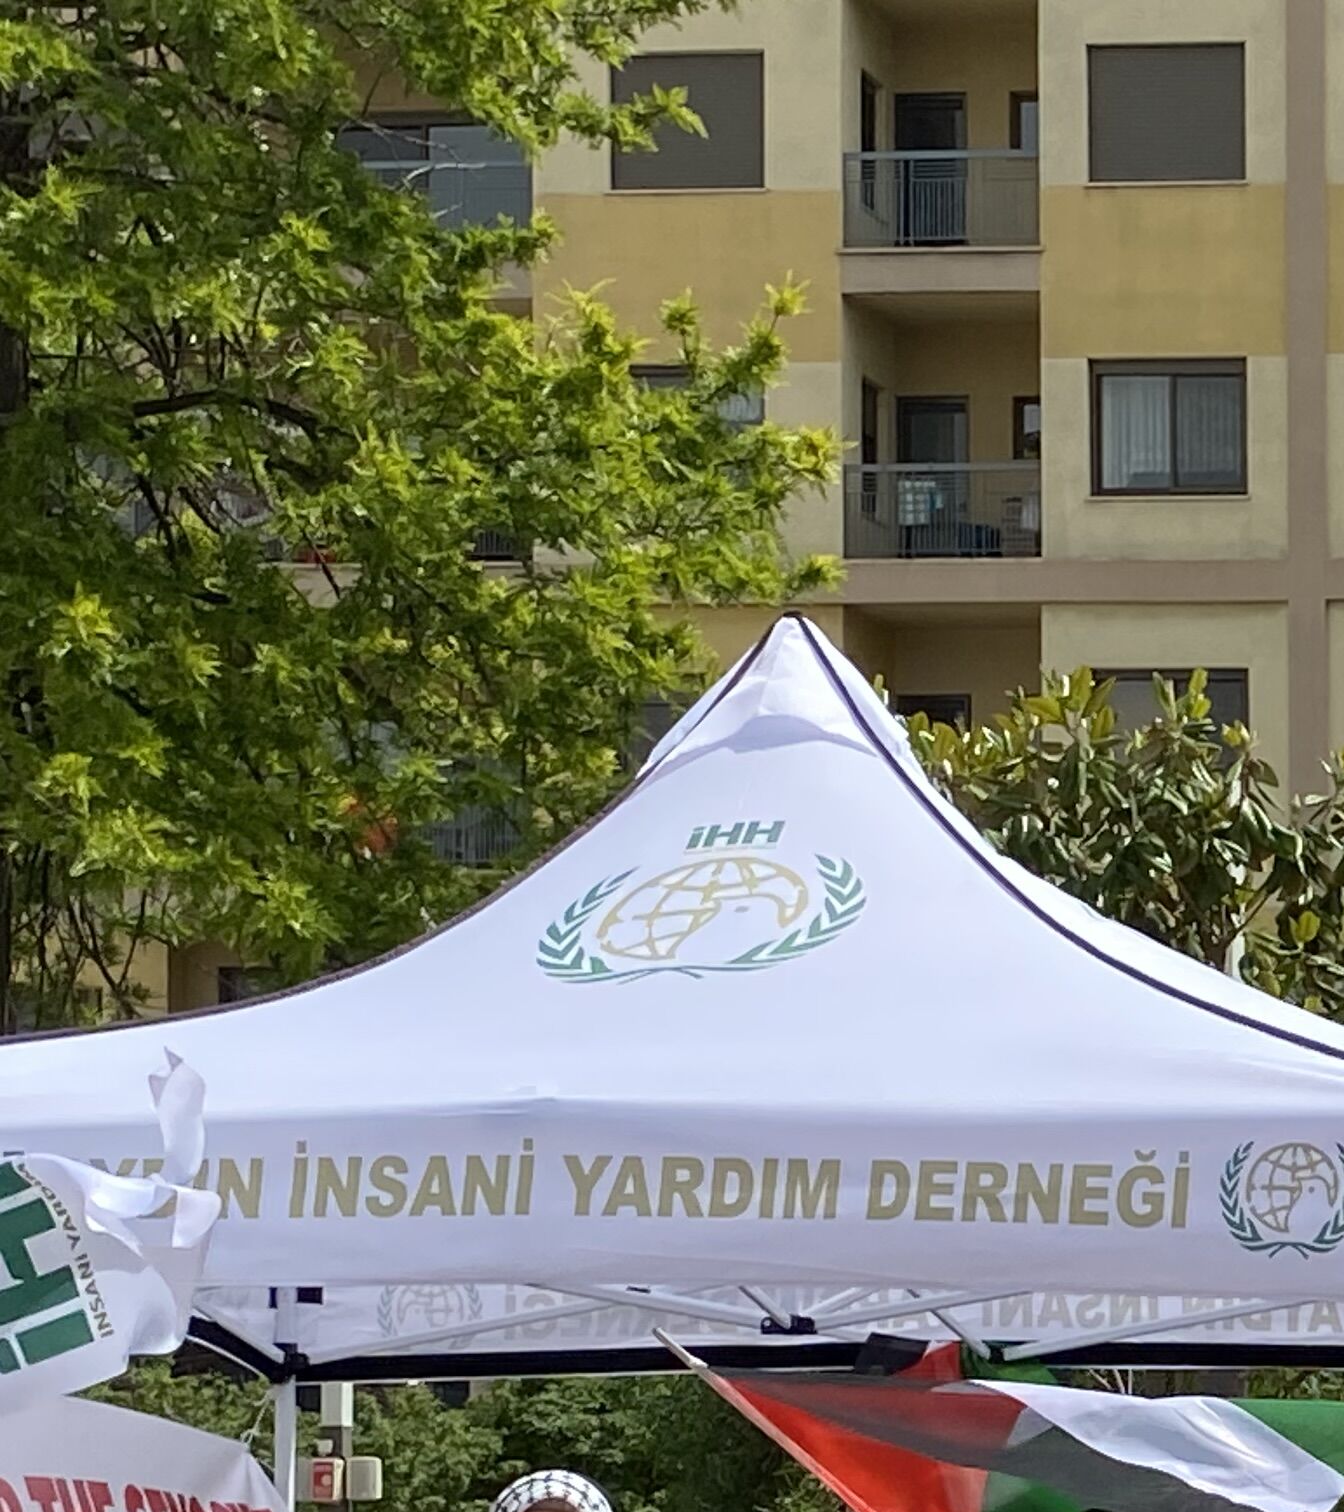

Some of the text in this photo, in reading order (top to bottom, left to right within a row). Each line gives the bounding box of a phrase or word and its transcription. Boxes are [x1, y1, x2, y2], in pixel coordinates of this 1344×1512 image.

[289, 1138, 533, 1219] İNSANİ
[563, 1155, 841, 1220] YARDIM
[866, 1150, 1190, 1229] DERNEĞİ
